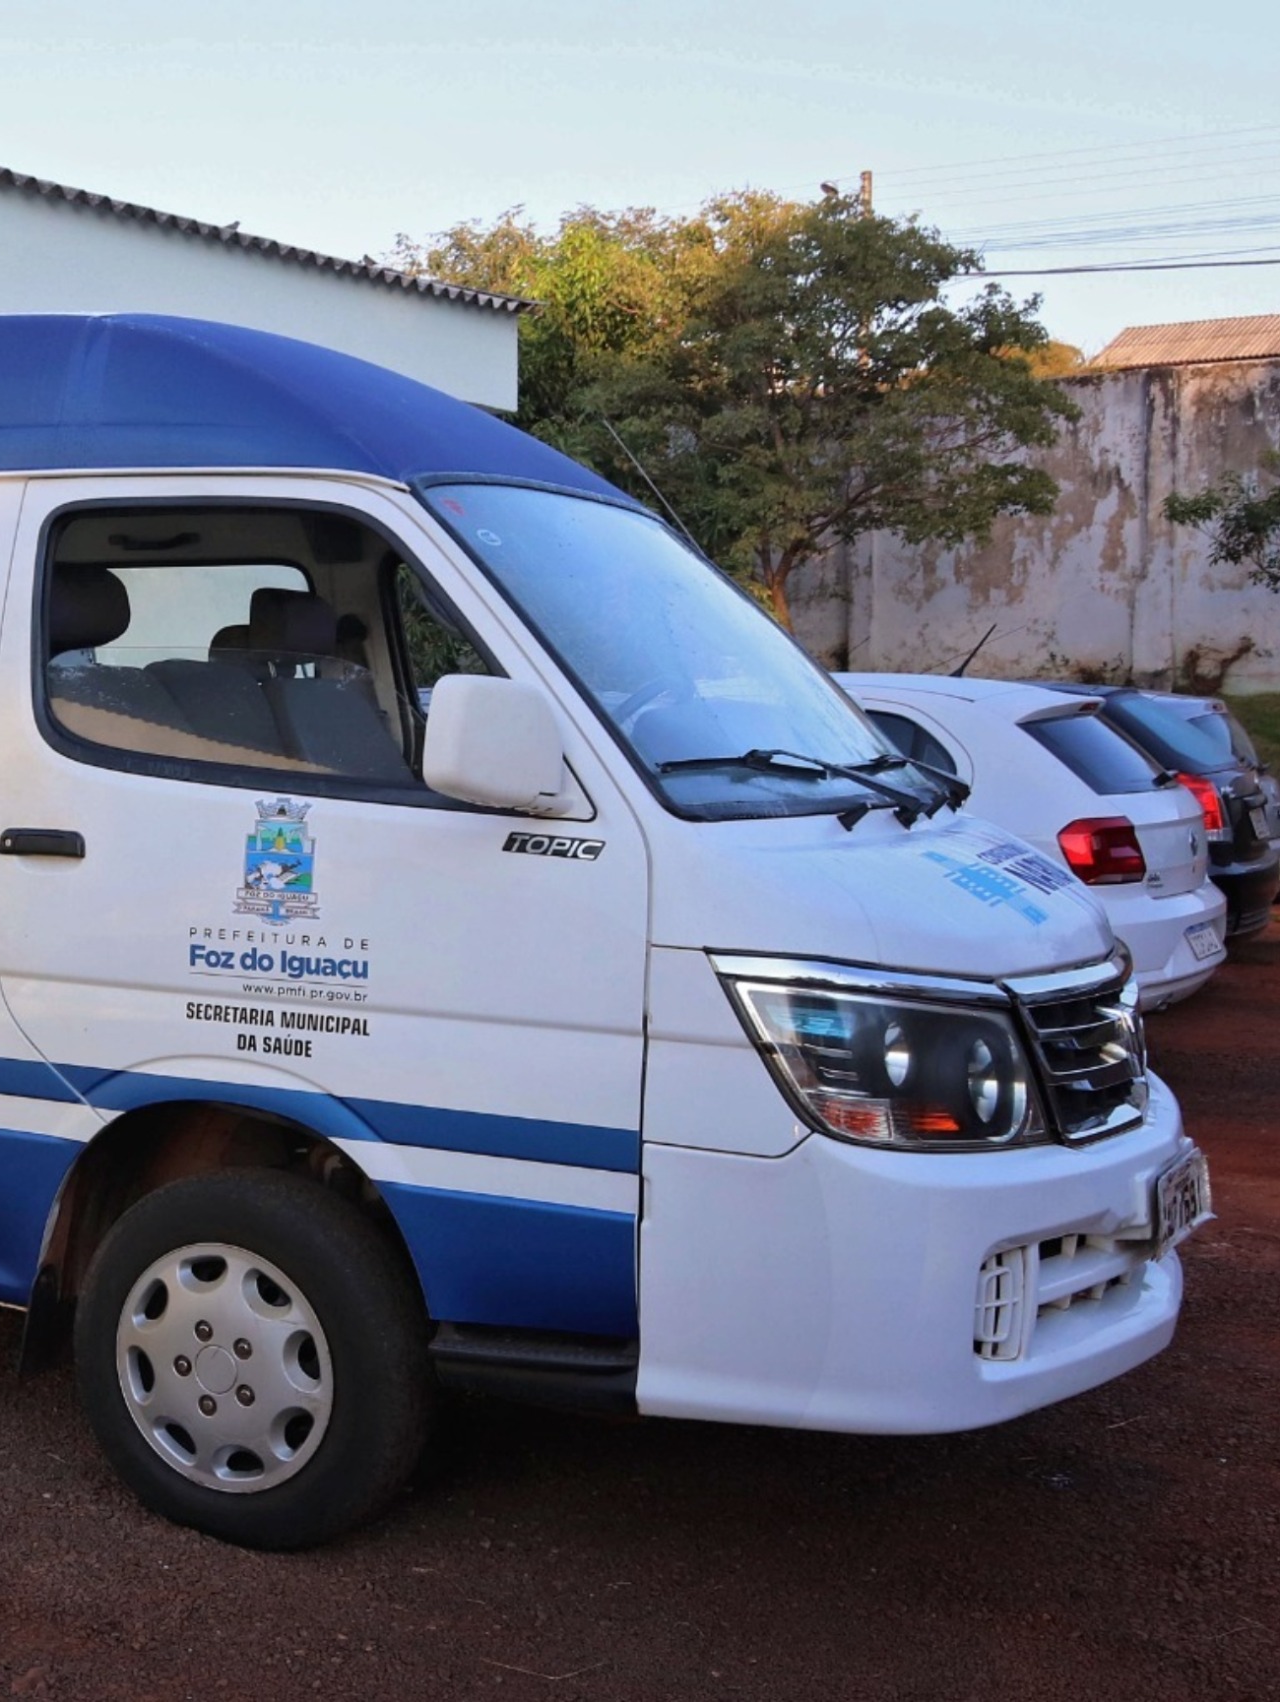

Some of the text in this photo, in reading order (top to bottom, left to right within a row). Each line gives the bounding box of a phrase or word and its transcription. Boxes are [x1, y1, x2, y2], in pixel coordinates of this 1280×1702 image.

[511, 834, 603, 859] TOPIC
[189, 927, 369, 950] PREFEITURA DE
[189, 944, 369, 980] Foz do Iguaçu
[242, 983, 368, 1002] www.pmfi.pr.gov.br
[186, 1002, 370, 1037] SECRETARIA MUNICIPAL
[237, 1034, 312, 1058] DA SAÚDE
